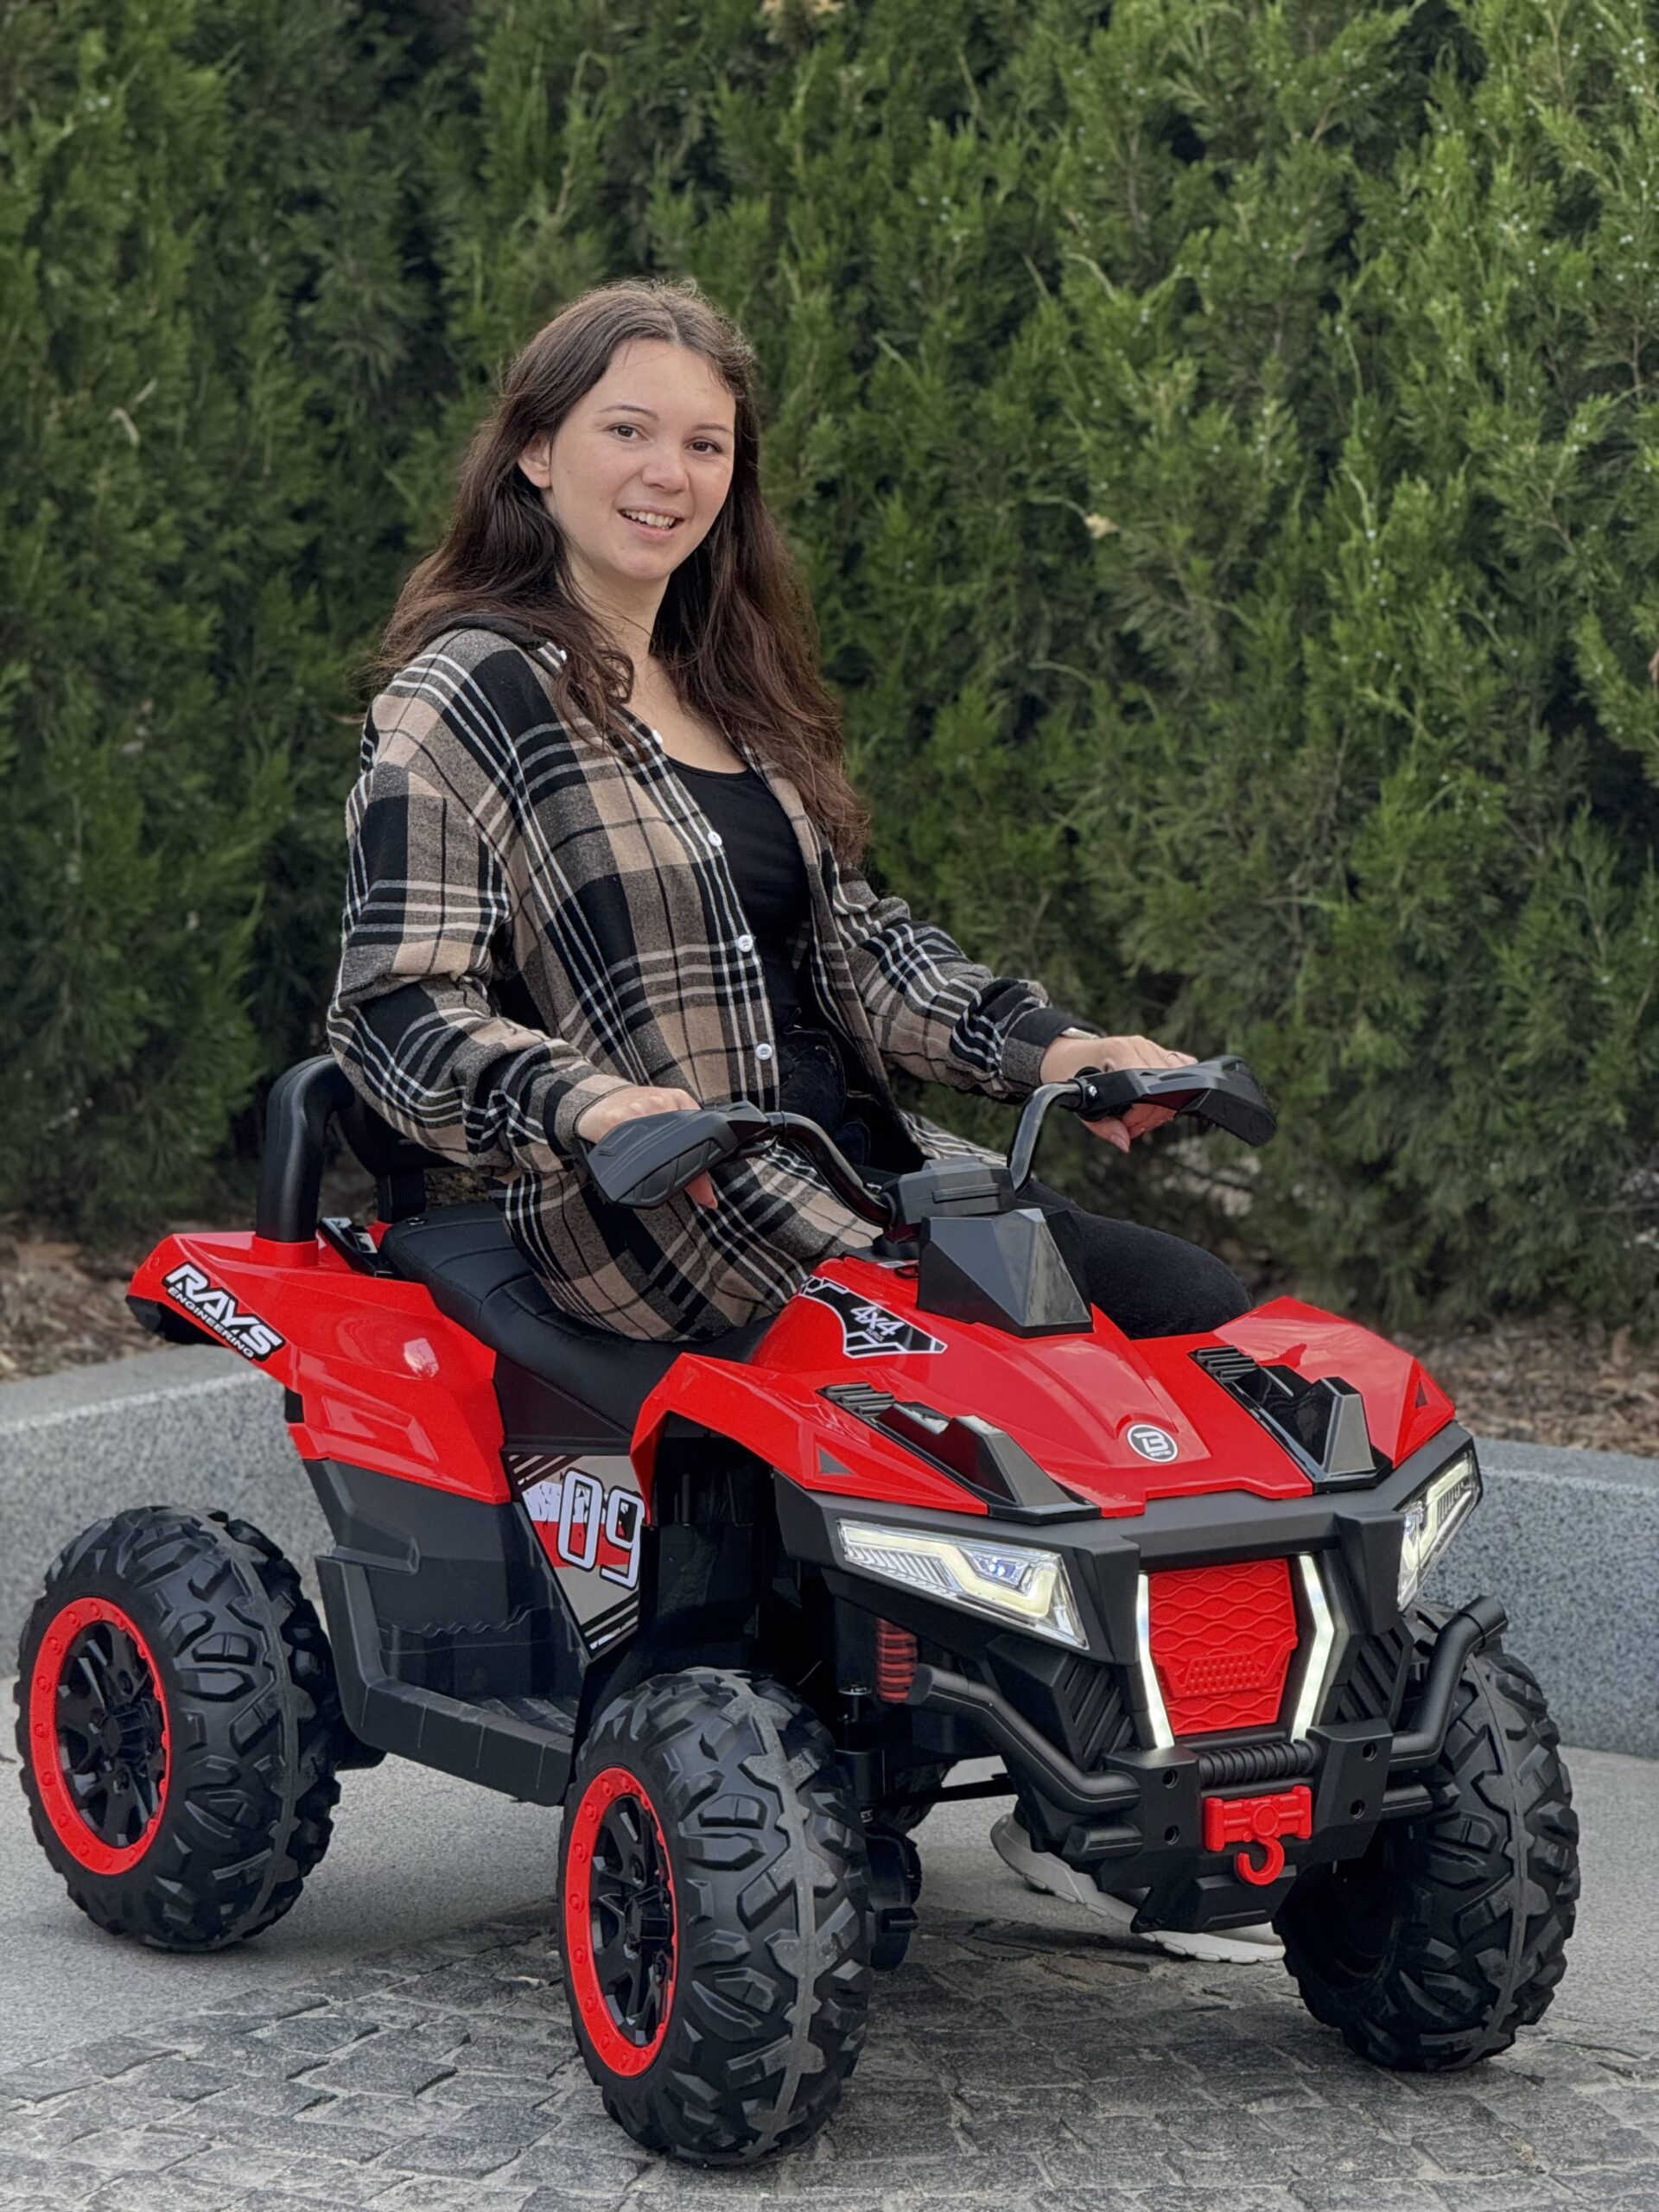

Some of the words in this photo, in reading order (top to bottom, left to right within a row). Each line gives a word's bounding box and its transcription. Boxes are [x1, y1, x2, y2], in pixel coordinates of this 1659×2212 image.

[166, 1265, 283, 1355] RAYS
[168, 1287, 254, 1358] ENGINEERING
[558, 1470, 645, 1588] 09
